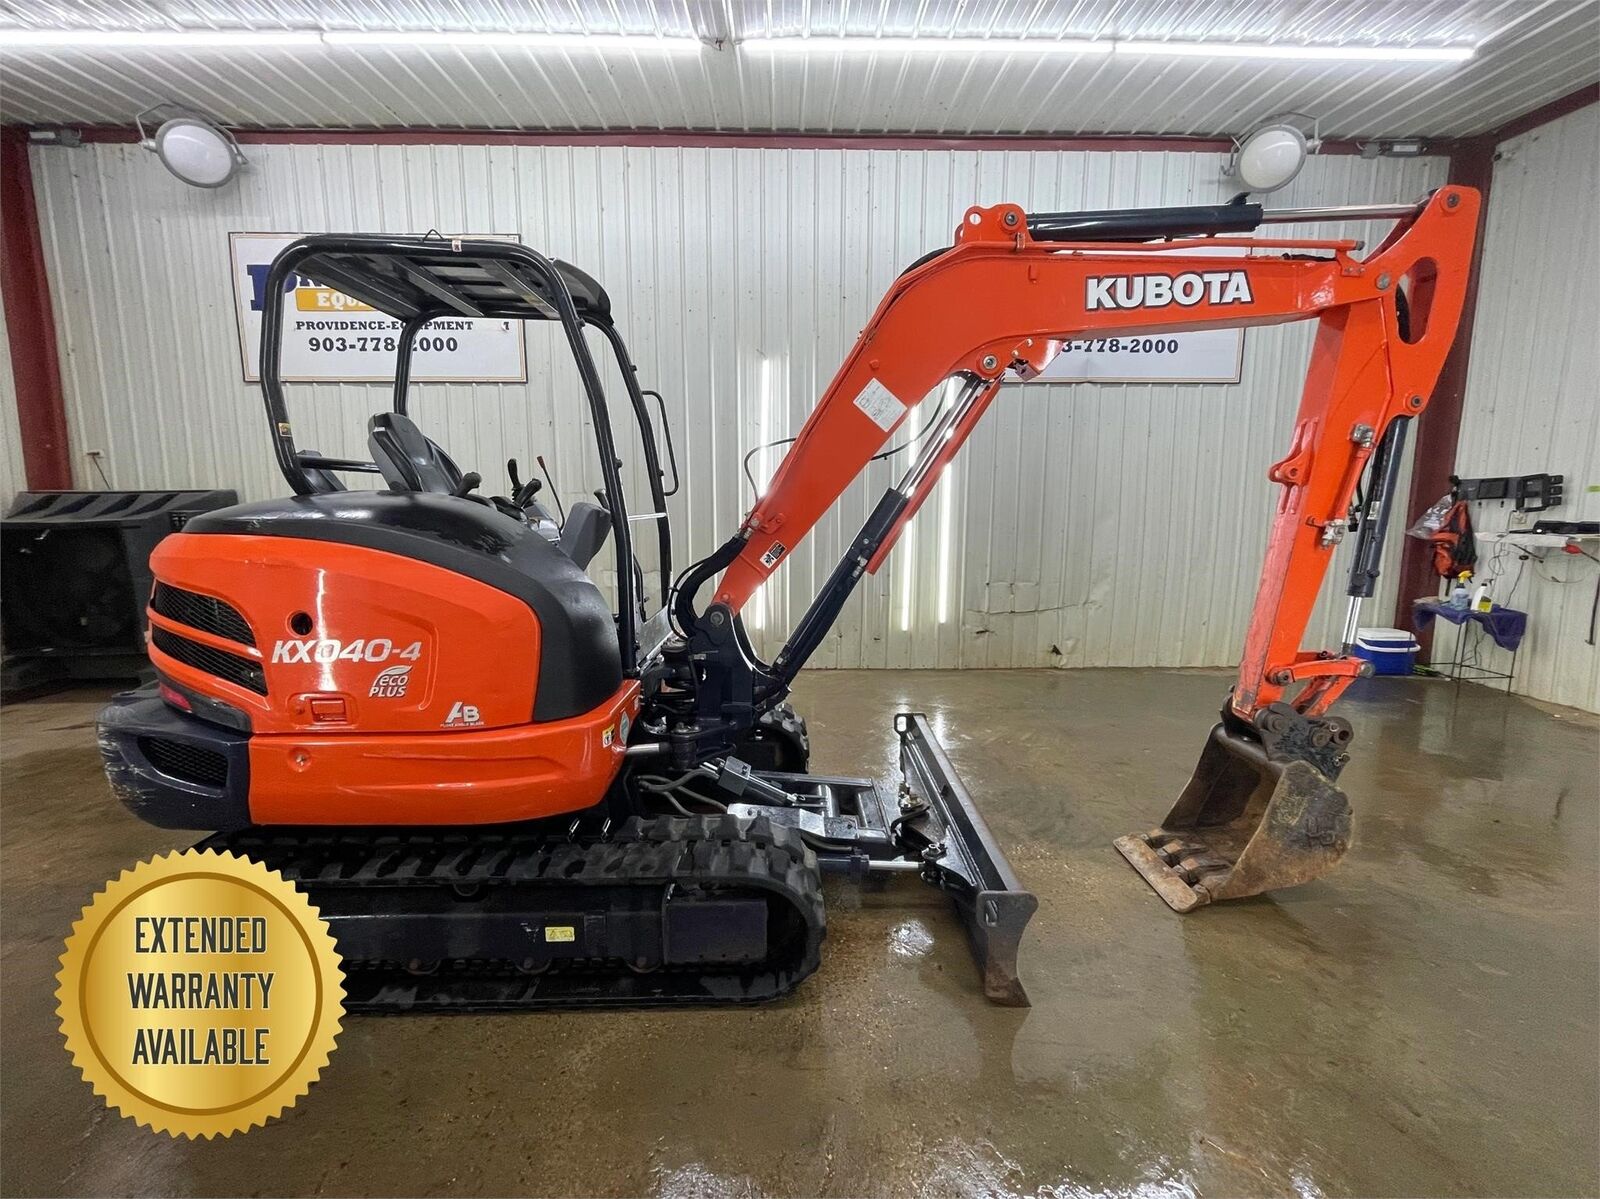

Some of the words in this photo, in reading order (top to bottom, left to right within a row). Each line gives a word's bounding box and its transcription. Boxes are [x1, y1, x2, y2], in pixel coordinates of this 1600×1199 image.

[1085, 270, 1253, 311] KUBOTA
[295, 321, 473, 331] PROVIDENCE-EPMENT
[308, 337, 458, 352] 903-778000
[271, 638, 422, 663] KX040-4
[368, 686, 407, 697] PLUS
